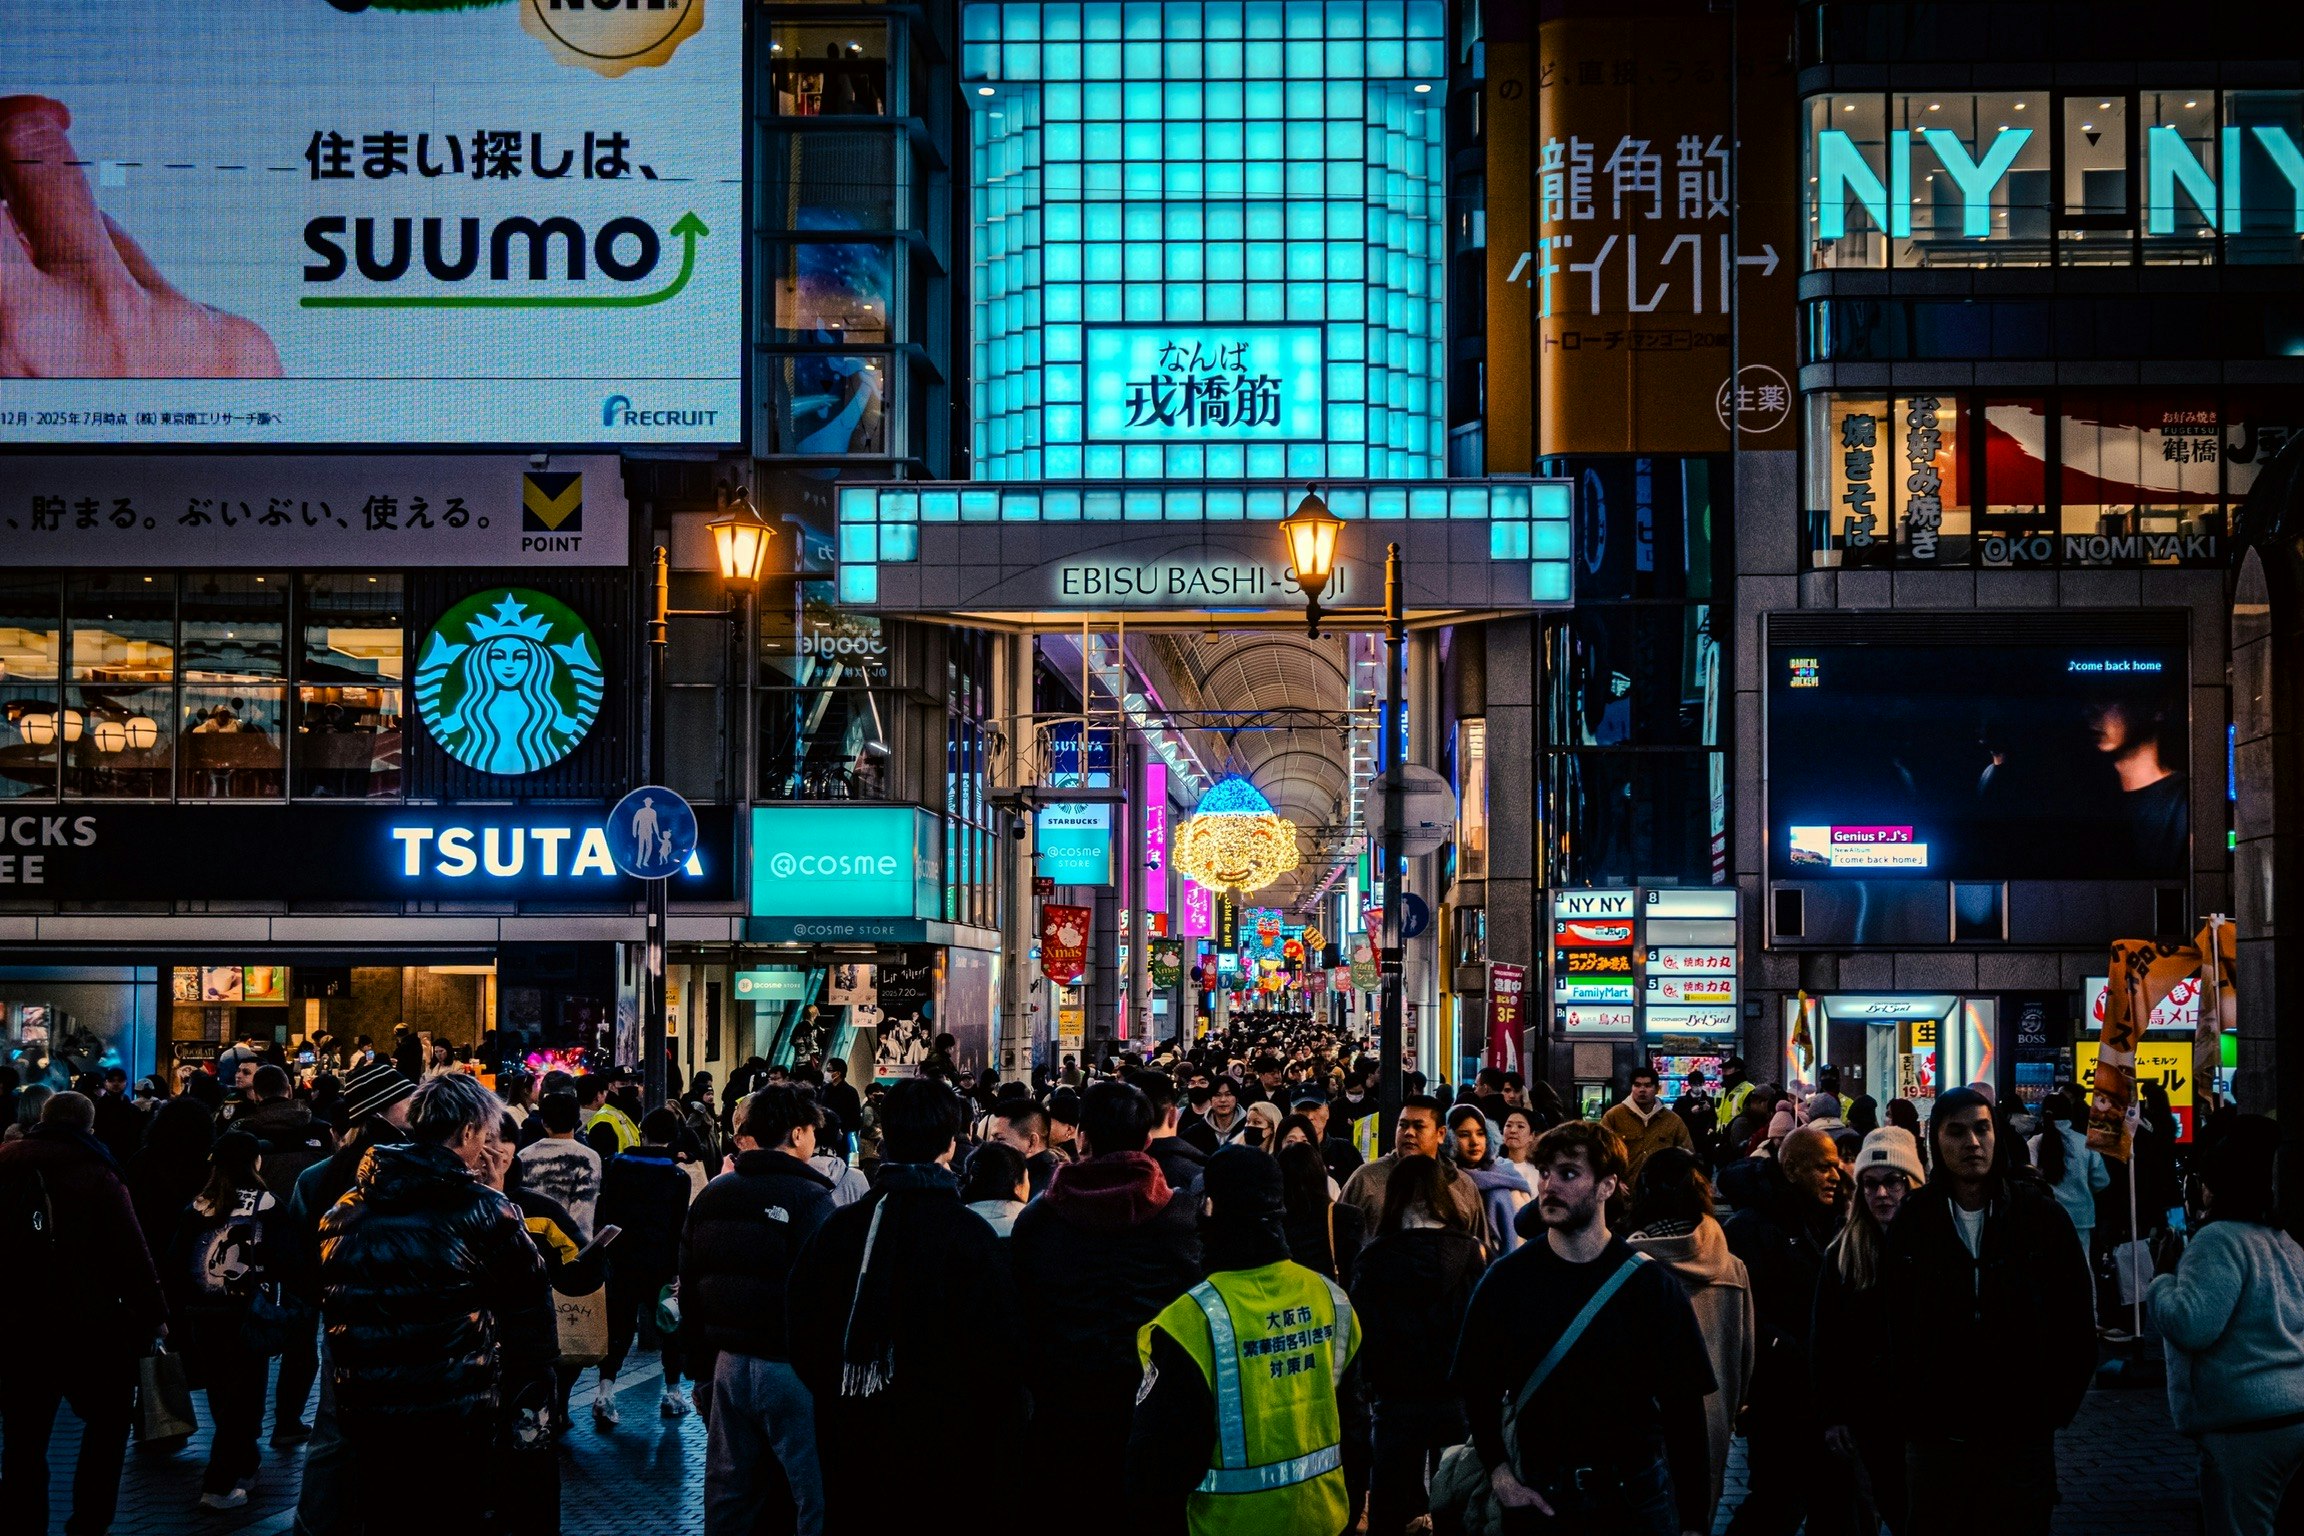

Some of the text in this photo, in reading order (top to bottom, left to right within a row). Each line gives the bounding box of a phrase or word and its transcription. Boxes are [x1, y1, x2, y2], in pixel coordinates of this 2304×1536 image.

[304, 130, 661, 181] 住まい探しは、
[1537, 134, 1741, 222] 龍角散
[1818, 129, 2035, 239] NY
[1158, 340, 1250, 372] なんば
[1124, 374, 1283, 430] 戎橋筋
[623, 410, 719, 426] RECRUIT
[2164, 427, 2215, 435] FUGETSU
[2162, 438, 2218, 464] 鶴橋
[1841, 414, 1878, 549] 焼きそば
[1905, 396, 1943, 560] お好み焼き
[522, 537, 582, 552] POINT
[1062, 566, 1346, 600] EBISU BASHI-SJI
[2075, 659, 2162, 672] come back home
[1834, 830, 1876, 842] Genius
[1047, 846, 1101, 858] @cosme
[770, 852, 898, 878] @cosme
[1058, 860, 1090, 868] STORE
[1867, 855, 1889, 864] back
[1556, 893, 1563, 902] 4
[1649, 893, 1657, 903] 8
[1569, 896, 1627, 913] NY NY
[794, 924, 895, 936] @cosme STORE
[1557, 922, 1565, 933] 3
[1225, 935, 1232, 948] ME
[1045, 947, 1082, 959] Xmas
[1557, 951, 1564, 960] 2
[1649, 951, 1657, 961] 6
[1558, 979, 1565, 989] 1
[1649, 979, 1657, 989] 5
[1572, 987, 1629, 1000] FamilyMart
[1497, 1006, 1516, 1023] 3F
[1598, 1013, 1631, 1025] 鳥メロ
[2018, 1034, 2046, 1044] BOSS
[1266, 1305, 1312, 1331] 大阪市
[1242, 1324, 1333, 1358] 繁華街客引き等
[1269, 1352, 1316, 1379] 対策員
